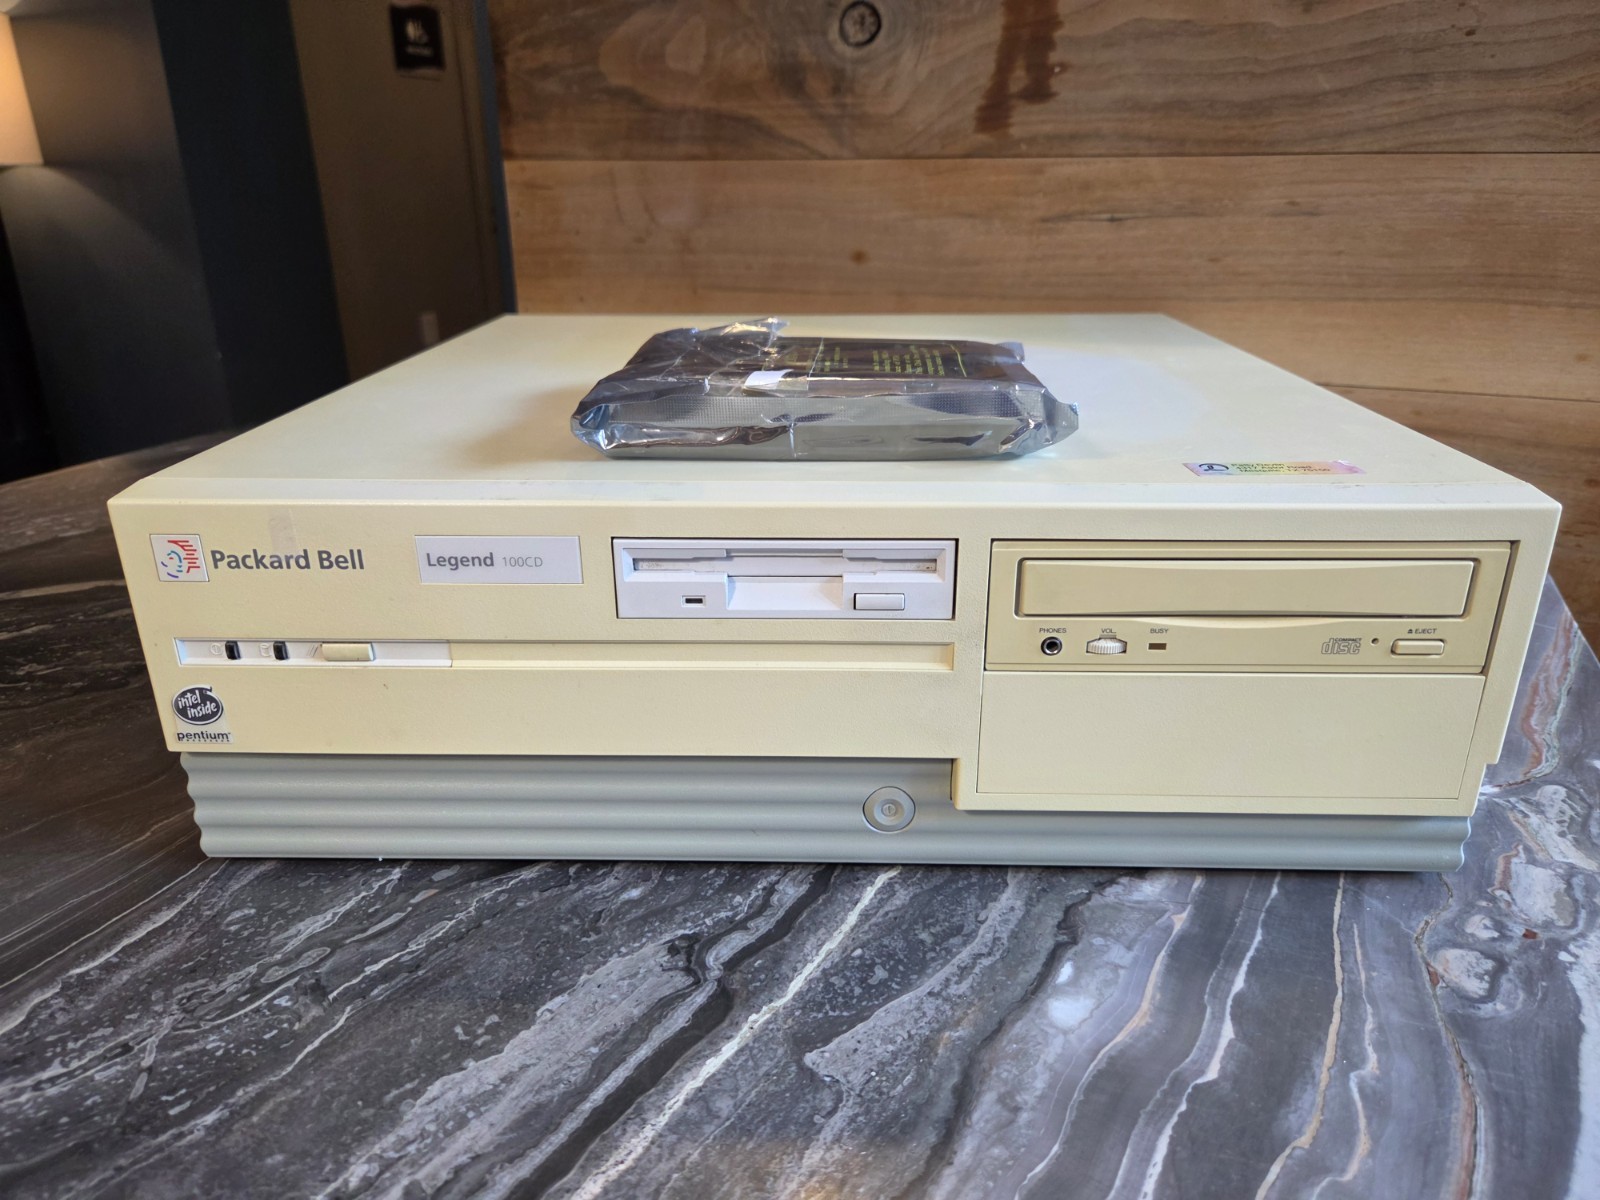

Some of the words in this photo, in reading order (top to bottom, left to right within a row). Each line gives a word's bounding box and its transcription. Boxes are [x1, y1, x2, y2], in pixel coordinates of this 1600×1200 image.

[210, 549, 311, 570] Packard
[317, 548, 365, 570] Bell
[426, 552, 495, 571] Legend
[502, 556, 544, 568] 100CD
[1414, 627, 1438, 635] EJECT
[1320, 637, 1362, 655] disc
[178, 690, 201, 709] intel
[187, 701, 217, 718] inside
[177, 730, 230, 742] pentium
